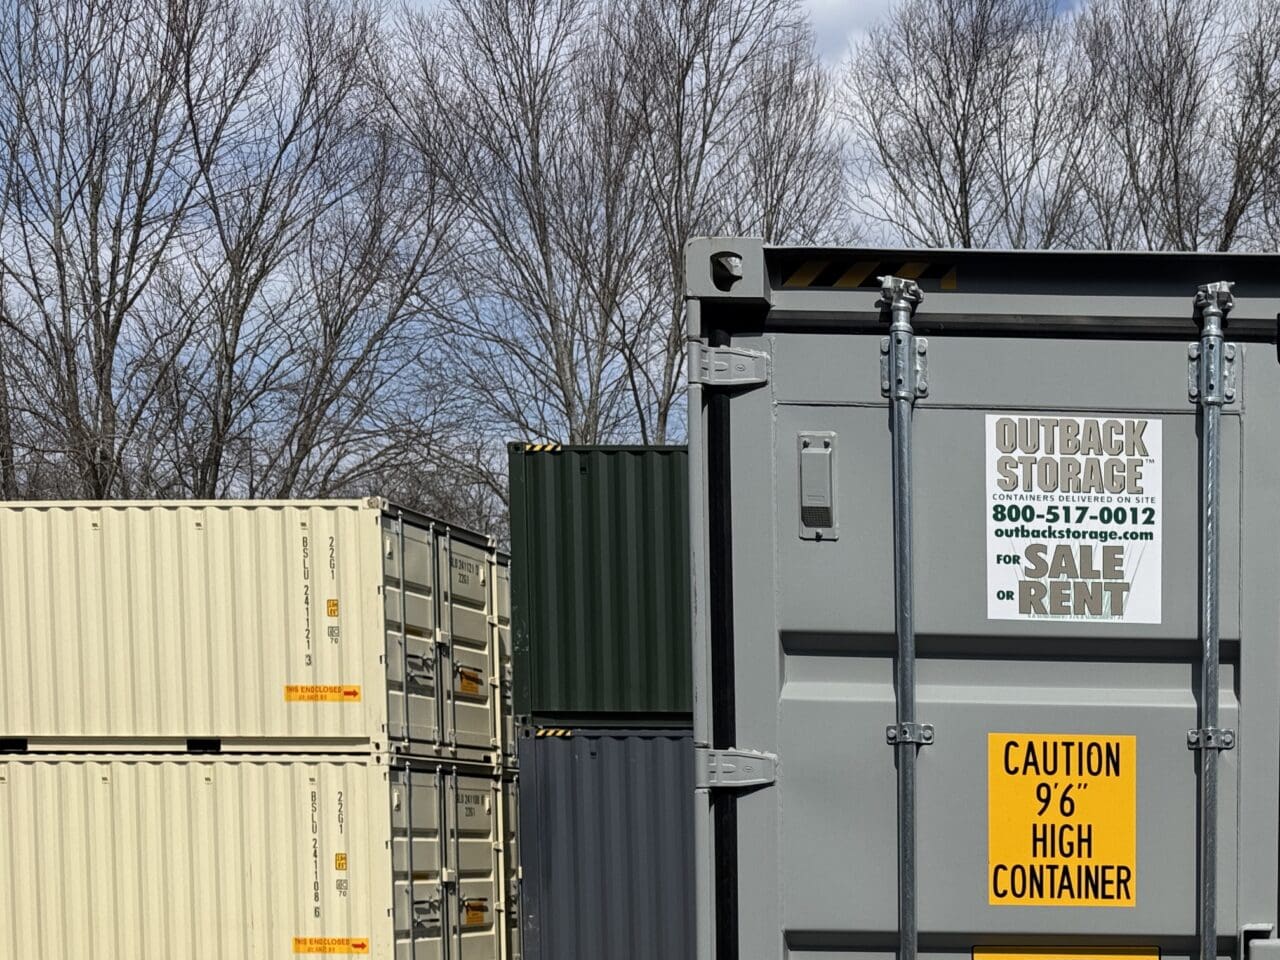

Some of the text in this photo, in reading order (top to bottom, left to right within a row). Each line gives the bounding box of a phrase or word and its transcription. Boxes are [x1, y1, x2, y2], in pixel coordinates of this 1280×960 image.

[995, 418, 1149, 456] OUTBACK
[996, 456, 1144, 494] STORAGE
[992, 493, 1156, 504] CONTAINERS DELIVERED ON SITE
[992, 504, 1156, 525] 800-517-0012
[994, 525, 1154, 542] outbackstorage.com
[996, 543, 1124, 579] FOR SALE
[996, 580, 1130, 616] OR RENT
[1003, 740, 1121, 777] CAUTION
[1031, 823, 1093, 858] HIGH
[992, 864, 1131, 900] CONTAINER
